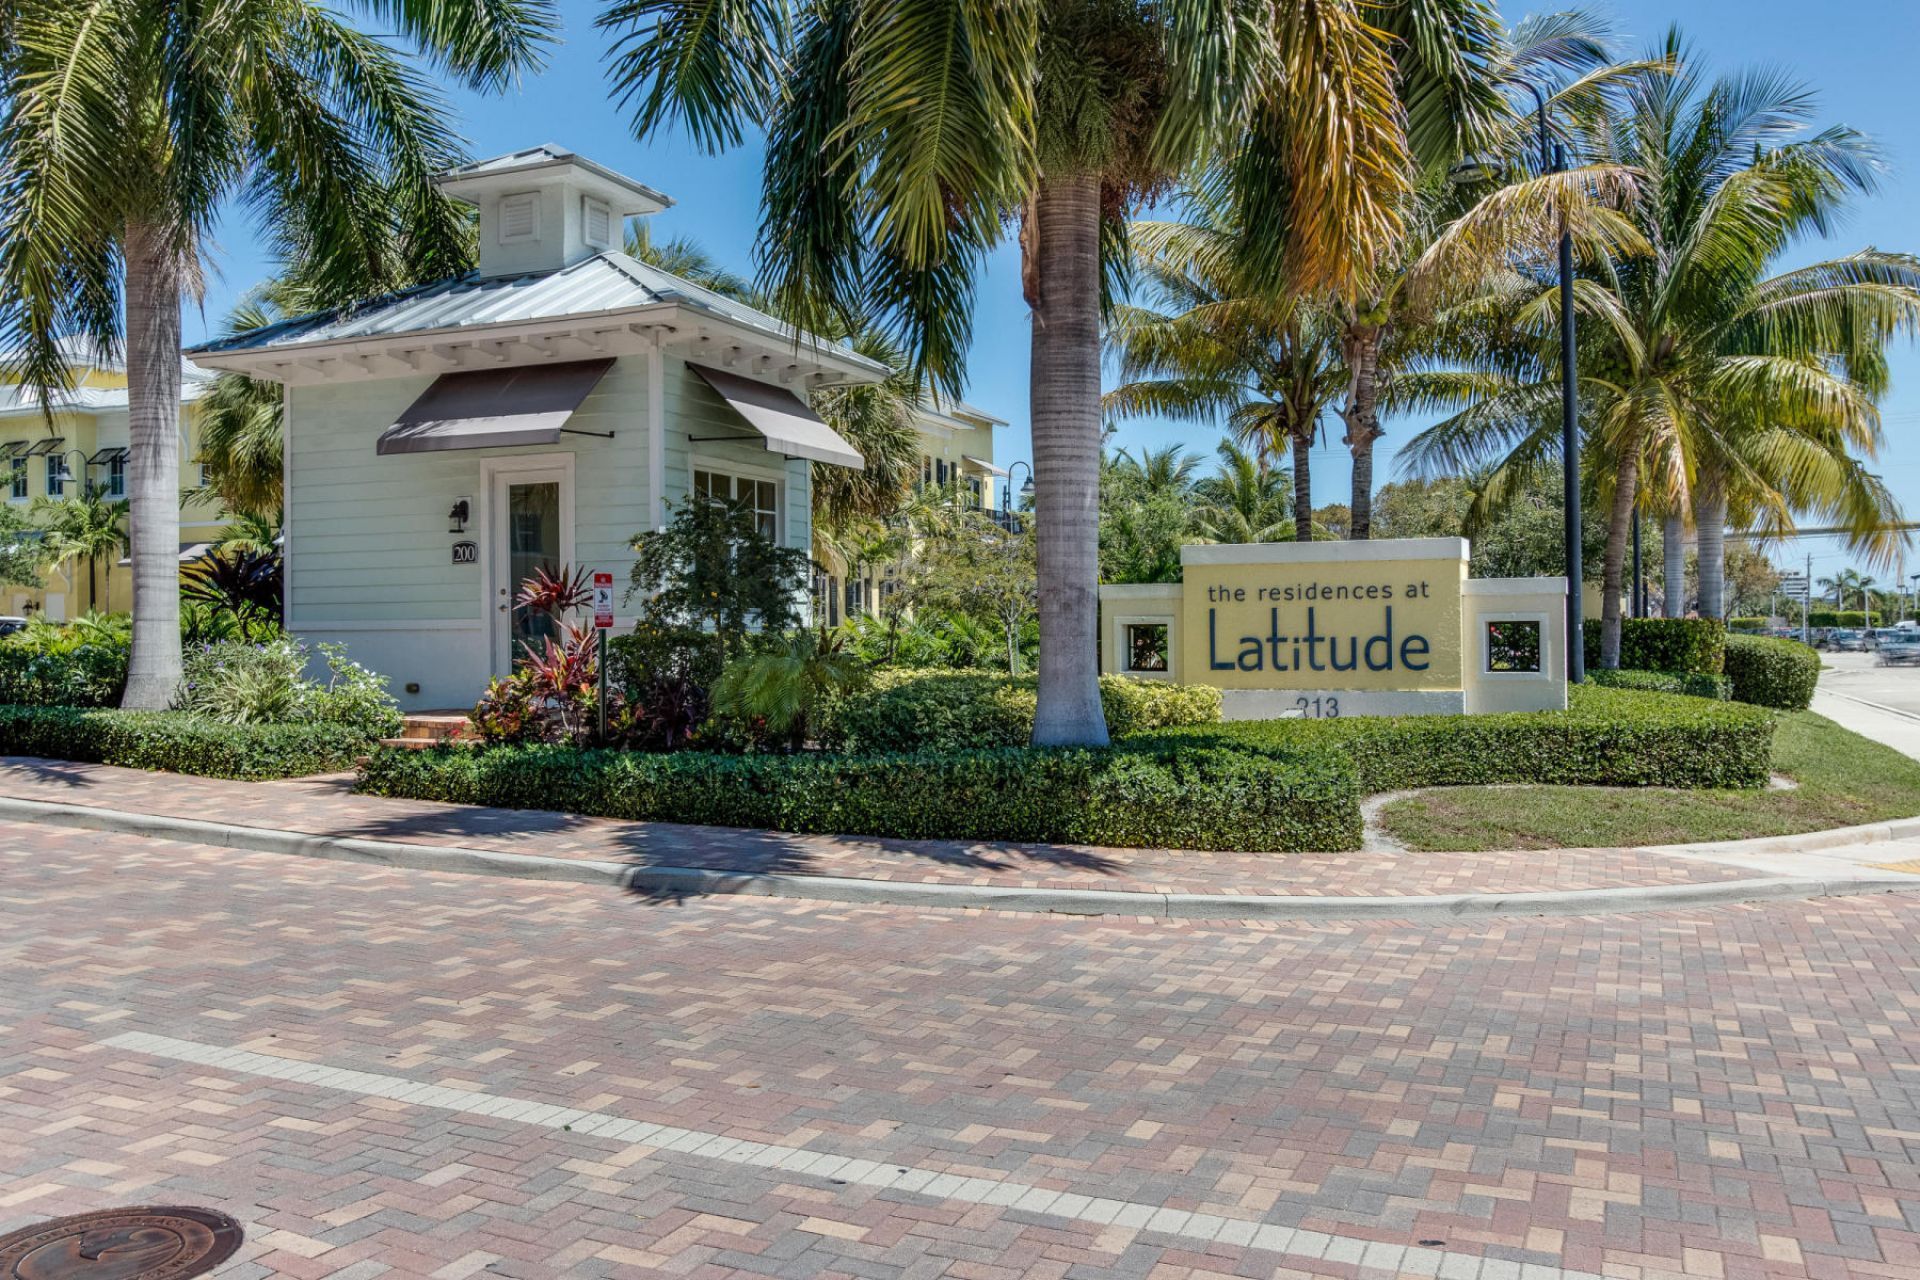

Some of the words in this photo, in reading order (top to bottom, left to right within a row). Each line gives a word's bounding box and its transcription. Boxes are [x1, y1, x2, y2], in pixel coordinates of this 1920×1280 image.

[455, 546, 474, 560] 200
[1208, 585, 1246, 602] the
[1259, 582, 1393, 601] residences
[1405, 580, 1430, 598] at
[1209, 605, 1430, 672] Latitude
